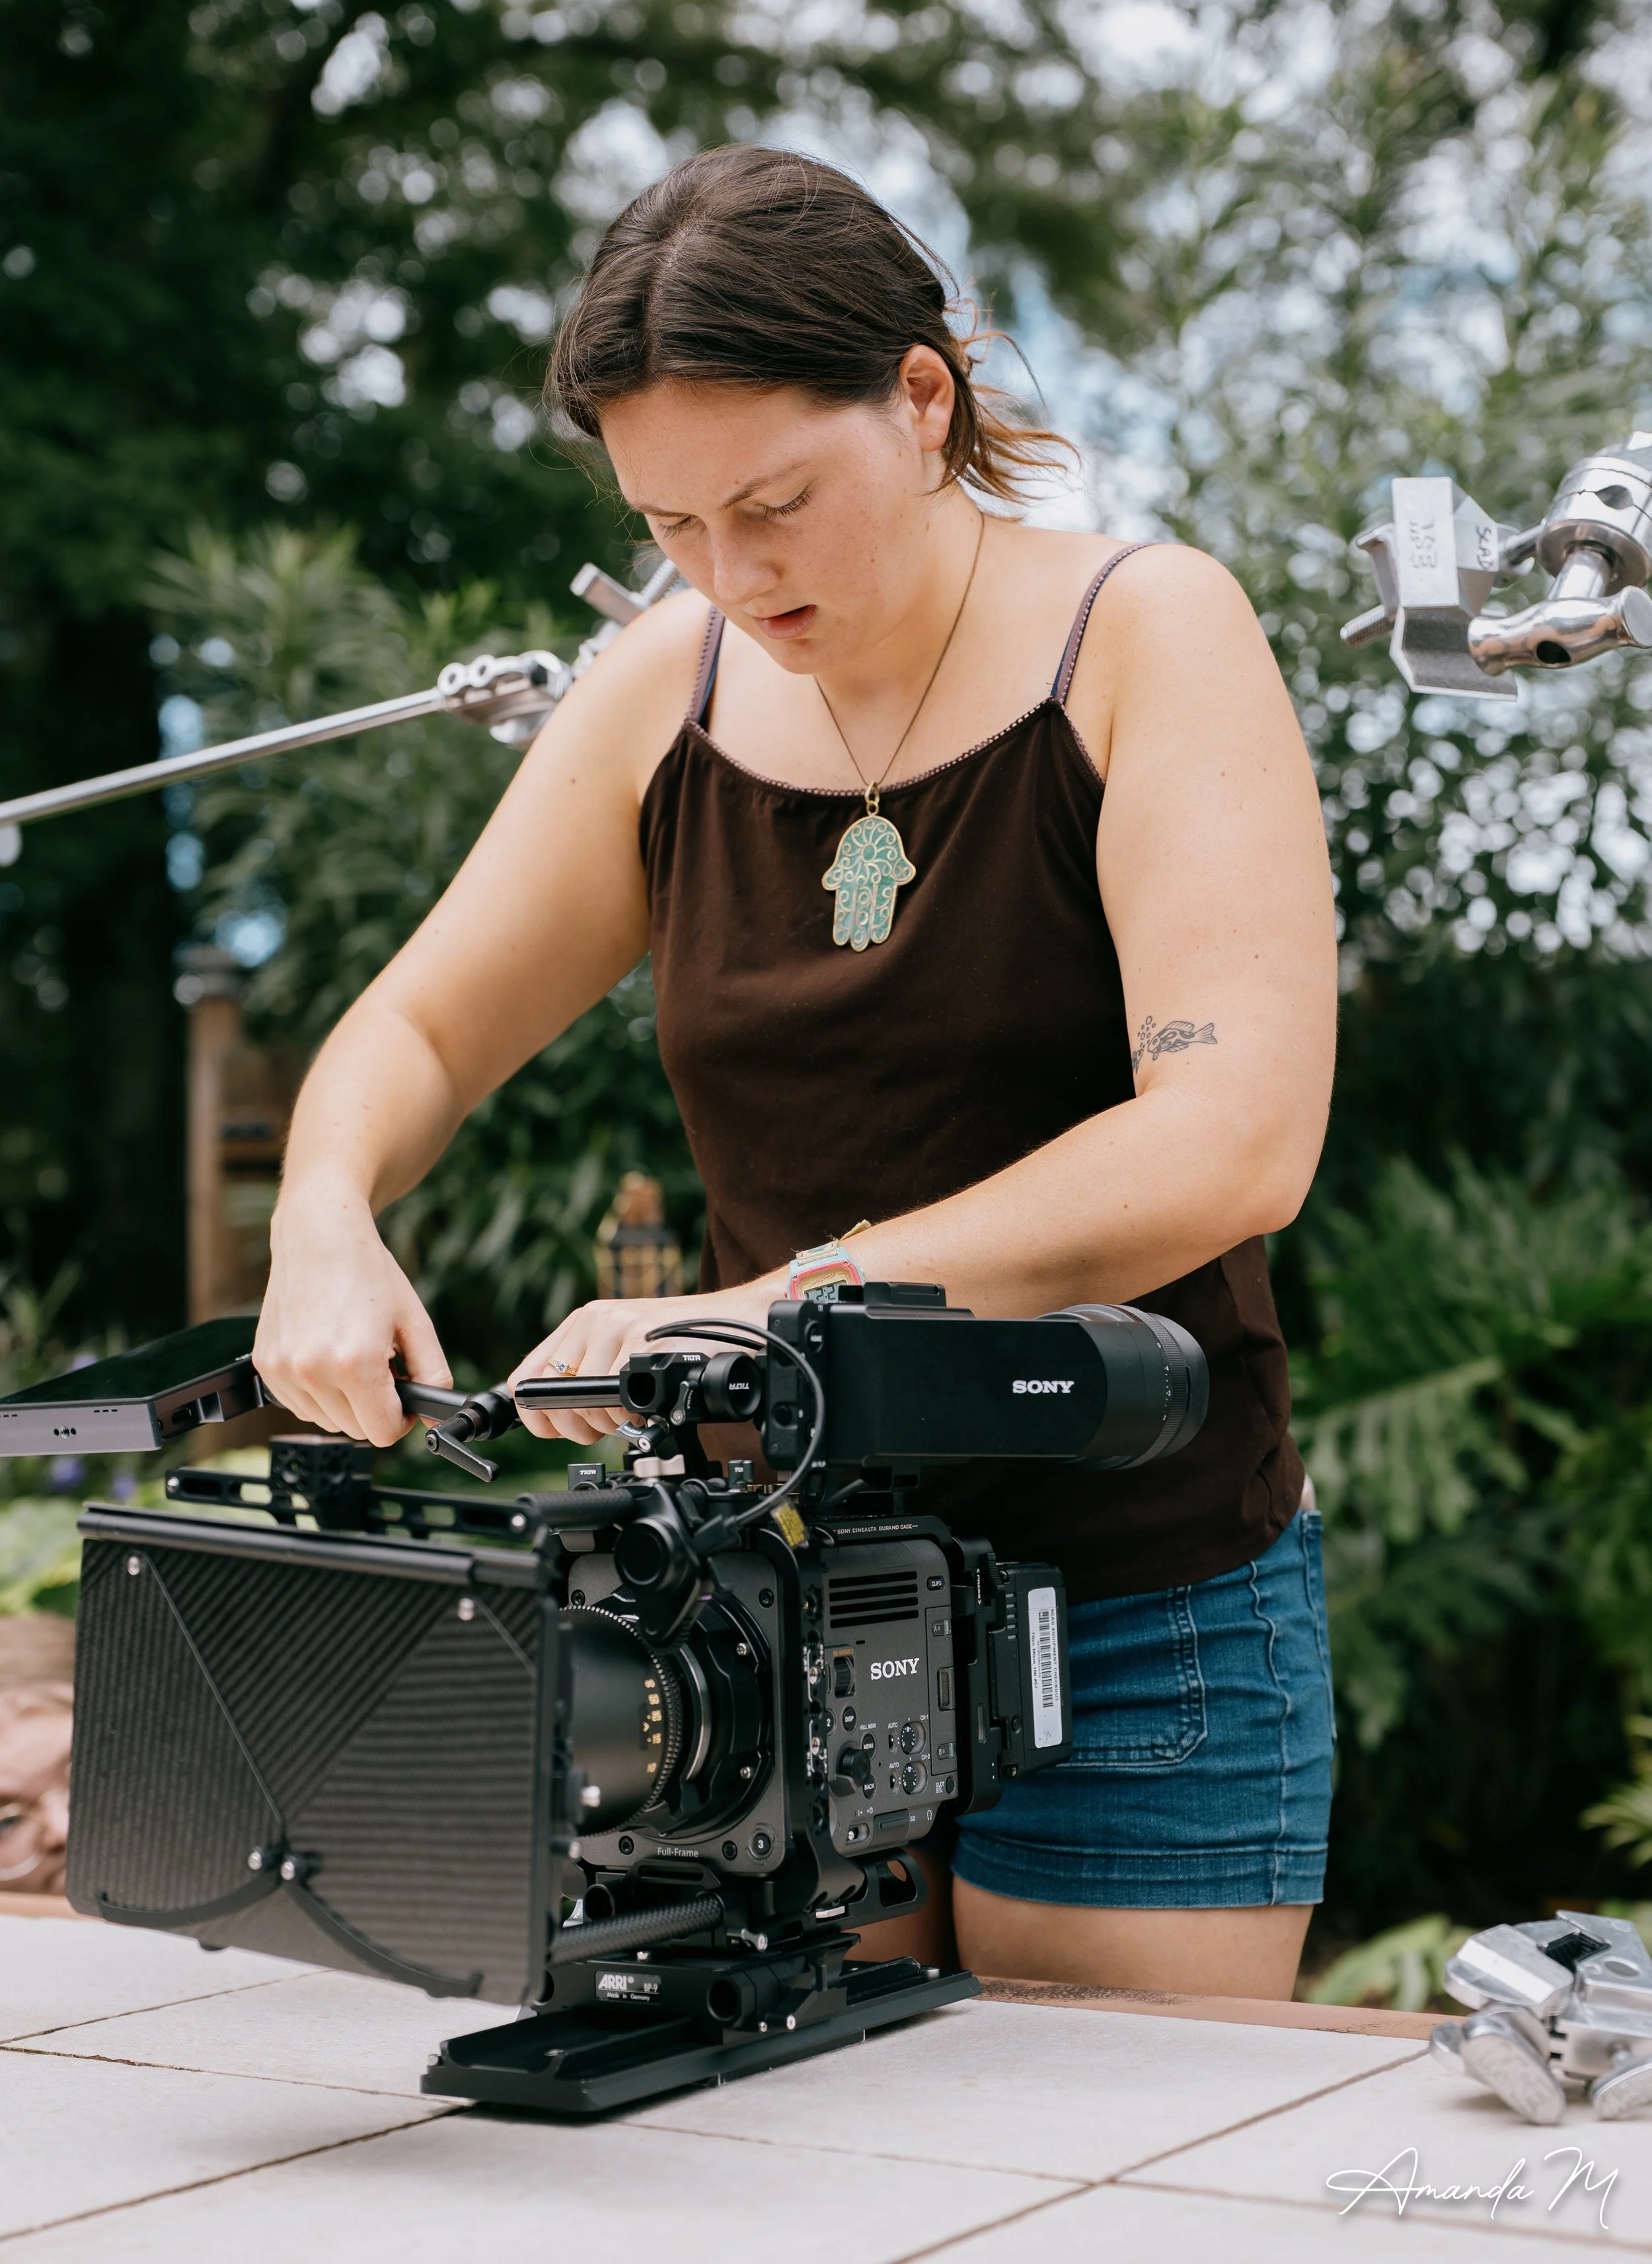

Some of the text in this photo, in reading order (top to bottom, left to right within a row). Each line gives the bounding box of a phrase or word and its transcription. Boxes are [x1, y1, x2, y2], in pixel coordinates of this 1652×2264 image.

[1476, 525, 1495, 570] SCAD
[1012, 1380, 1074, 1394] SONY
[870, 1657, 920, 1680] SONY
[827, 1717, 831, 1727] 2
[757, 1839, 765, 1849] 3
[657, 1847, 698, 1858] Full-Frame
[644, 1982, 658, 1992] BP-9
[630, 1993, 650, 2002] Germany
